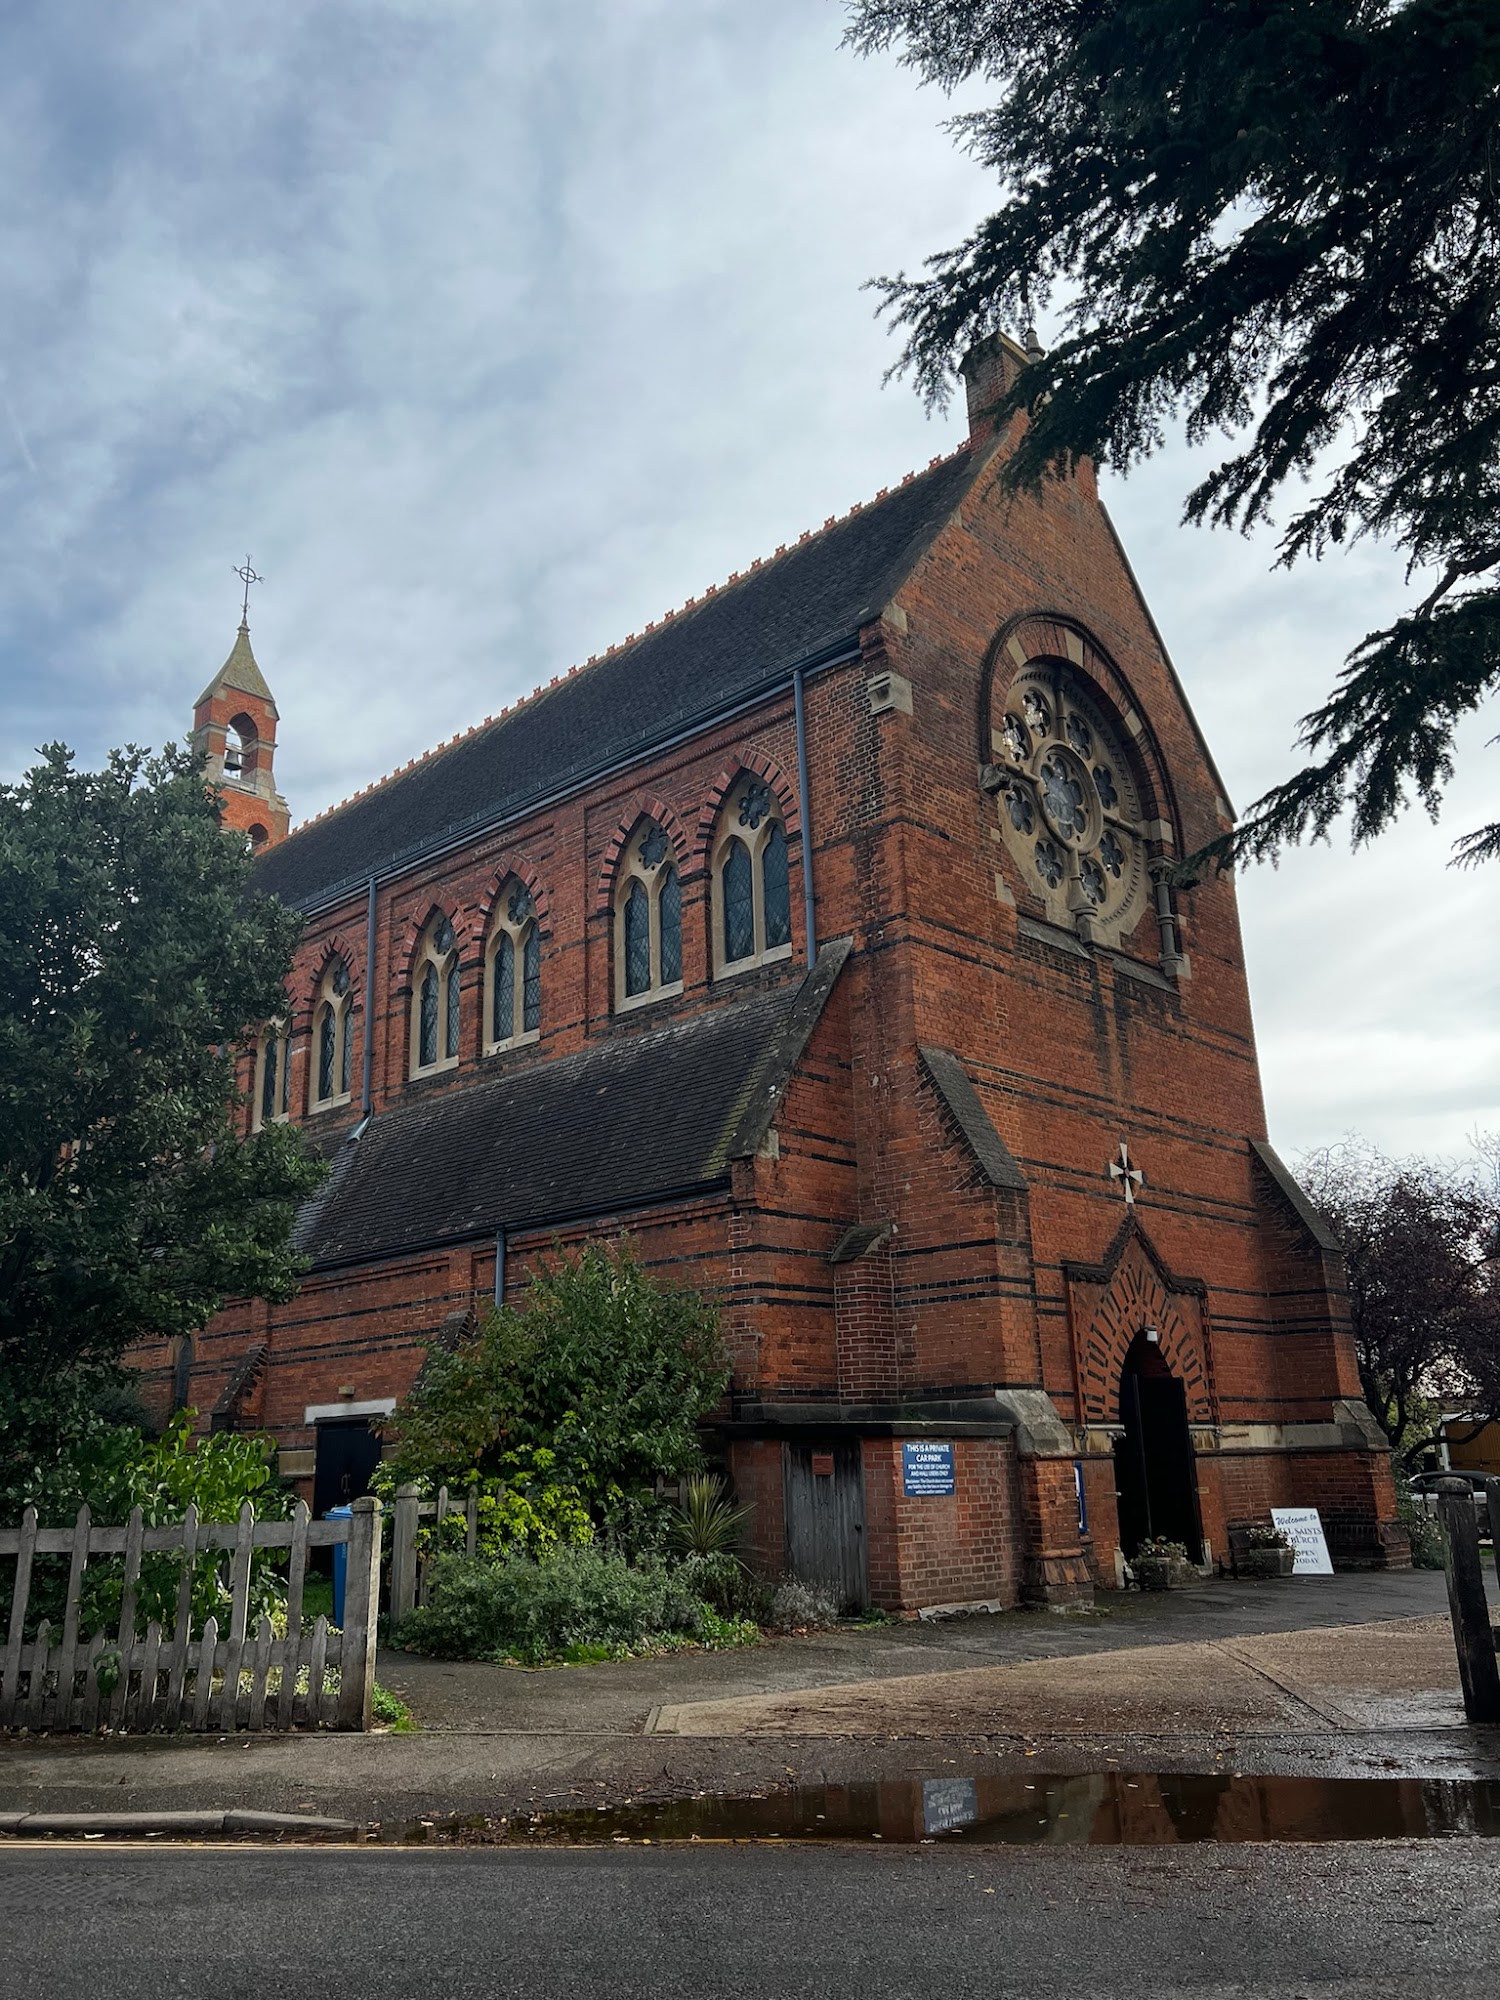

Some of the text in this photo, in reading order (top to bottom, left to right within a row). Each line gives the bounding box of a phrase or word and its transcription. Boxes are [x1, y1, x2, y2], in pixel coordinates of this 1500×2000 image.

[906, 1444, 919, 1452] THIS
[920, 1444, 924, 1452] IS
[930, 1444, 949, 1452] PRIVATE
[1276, 1516, 1308, 1525] Welcome
